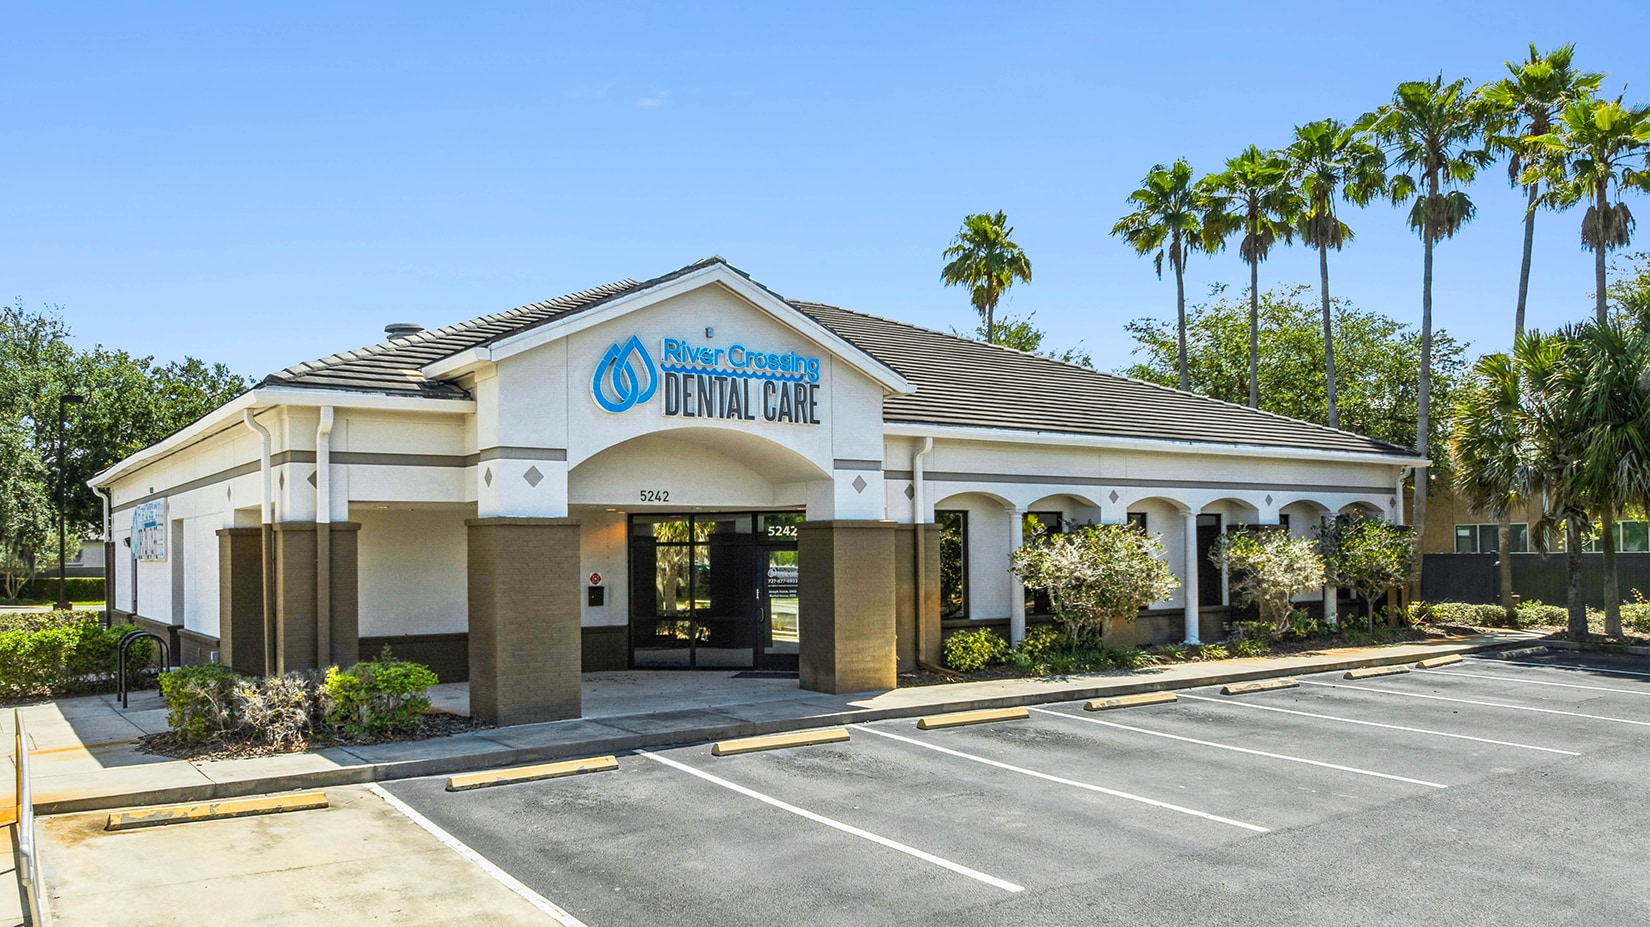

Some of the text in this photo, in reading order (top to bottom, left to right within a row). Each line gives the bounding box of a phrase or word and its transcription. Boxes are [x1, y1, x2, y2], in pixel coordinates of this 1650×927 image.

[662, 338, 820, 383] River Crossing
[663, 372, 820, 425] DENTAL CARE
[640, 490, 670, 502] 5242
[767, 525, 798, 537] 5242
